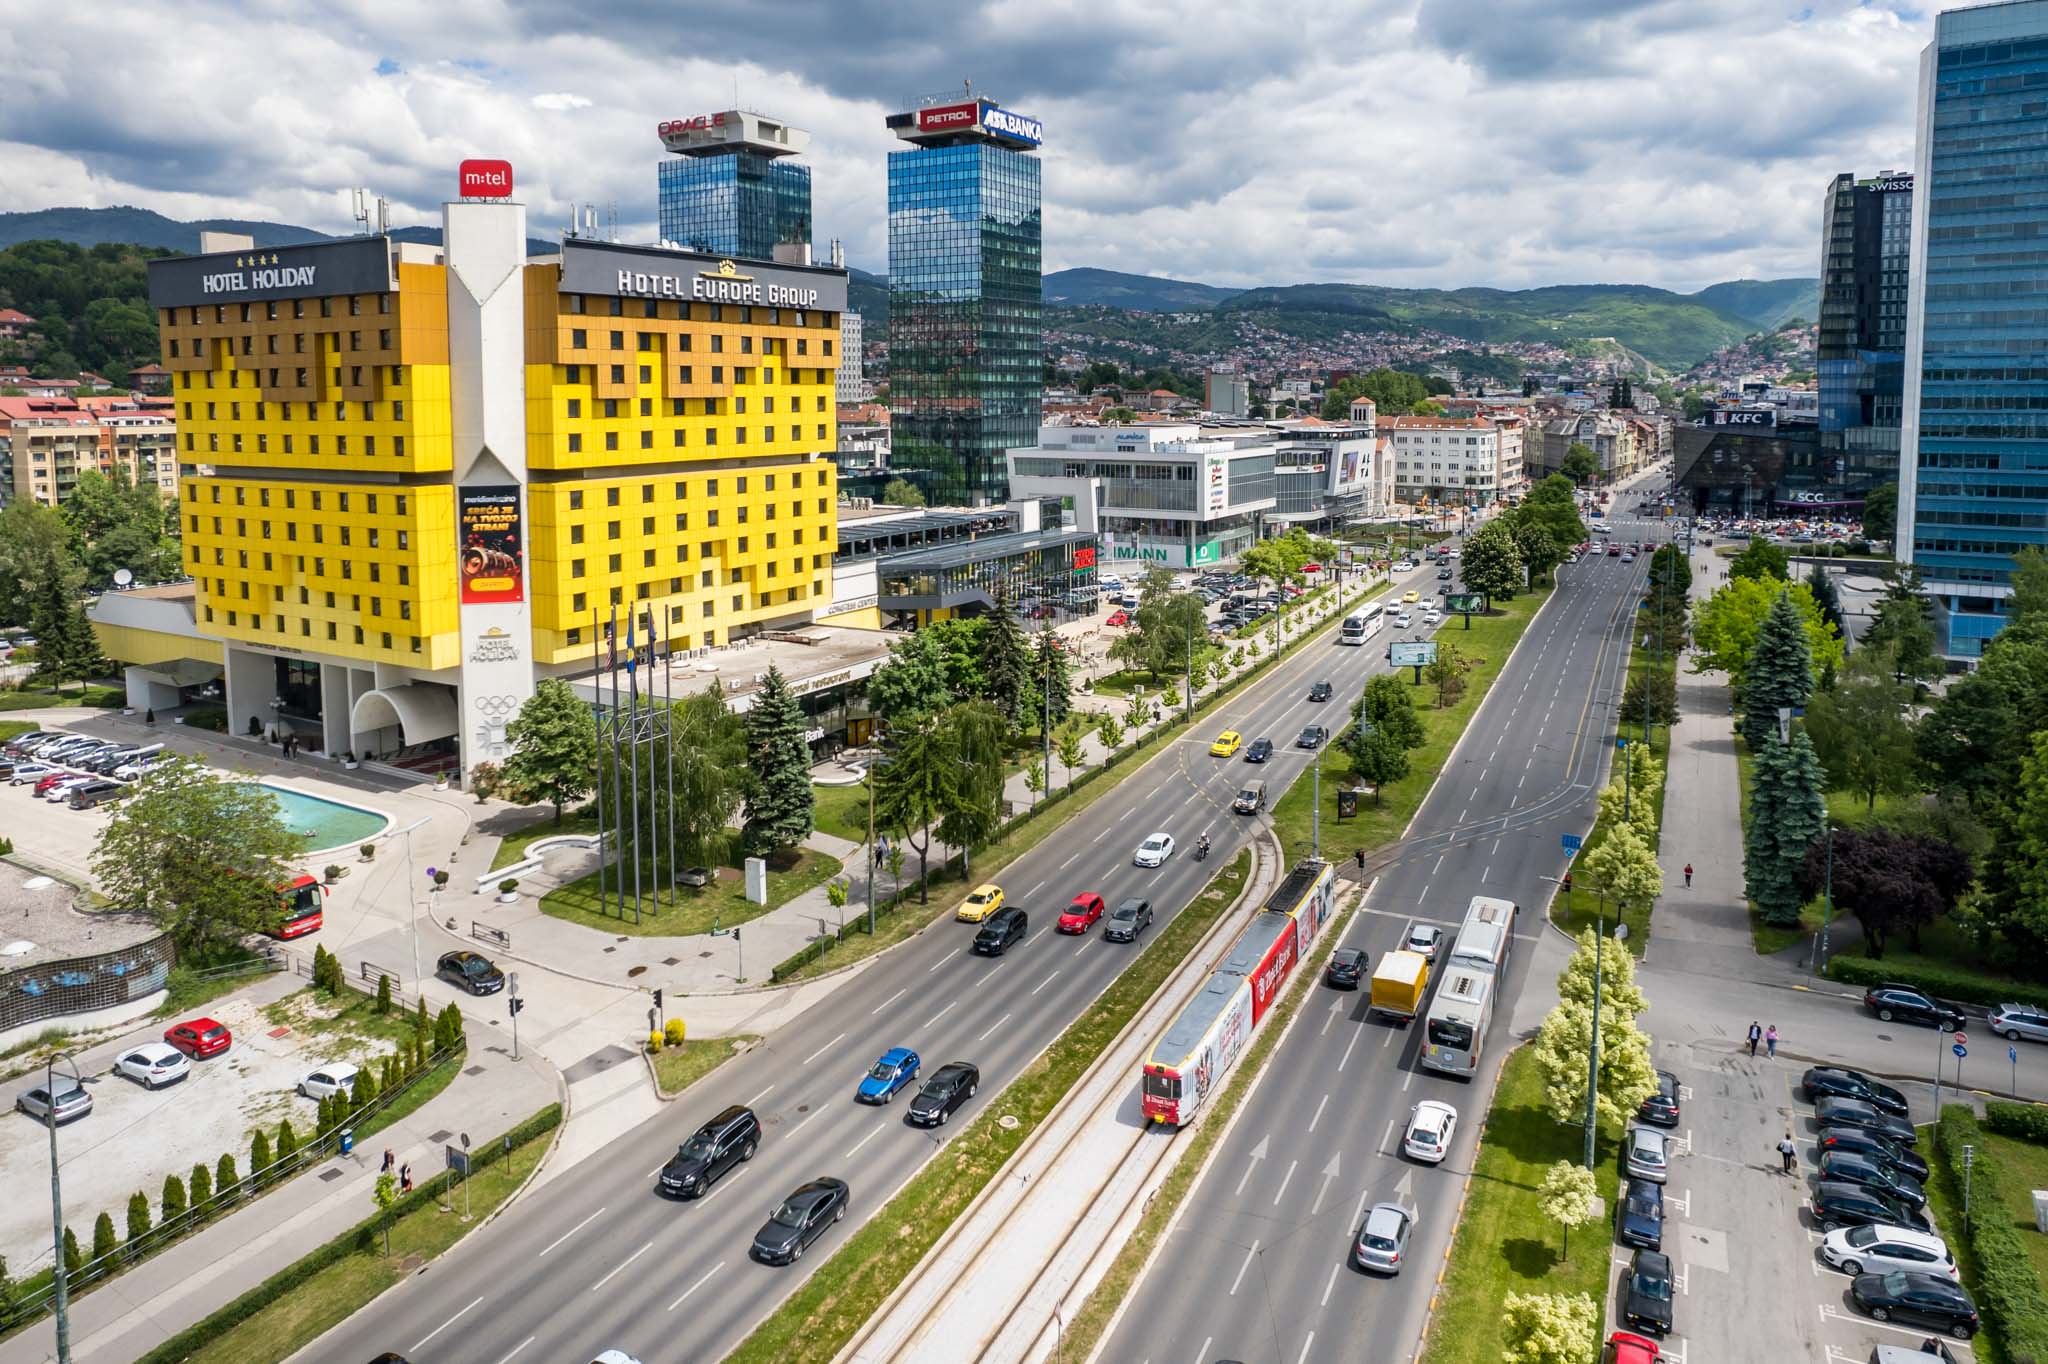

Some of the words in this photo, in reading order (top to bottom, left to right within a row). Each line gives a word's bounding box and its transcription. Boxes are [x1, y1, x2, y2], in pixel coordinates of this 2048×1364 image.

[658, 112, 725, 135] ORACLE
[927, 111, 971, 124] PETROL
[1007, 115, 1042, 141] BANKA
[466, 170, 506, 185] m:tel
[203, 272, 248, 293] HOTEL
[252, 266, 316, 289] HOLIDAY
[618, 270, 684, 297] HOTEL
[693, 277, 761, 302] EUROPE
[768, 284, 817, 306] GROUP
[1721, 390, 1738, 399] dm
[1730, 413, 1762, 424] KFC
[1798, 492, 1825, 503] SCC
[502, 506, 514, 514] JE
[472, 523, 509, 531] STRANI
[805, 727, 825, 743] Bank
